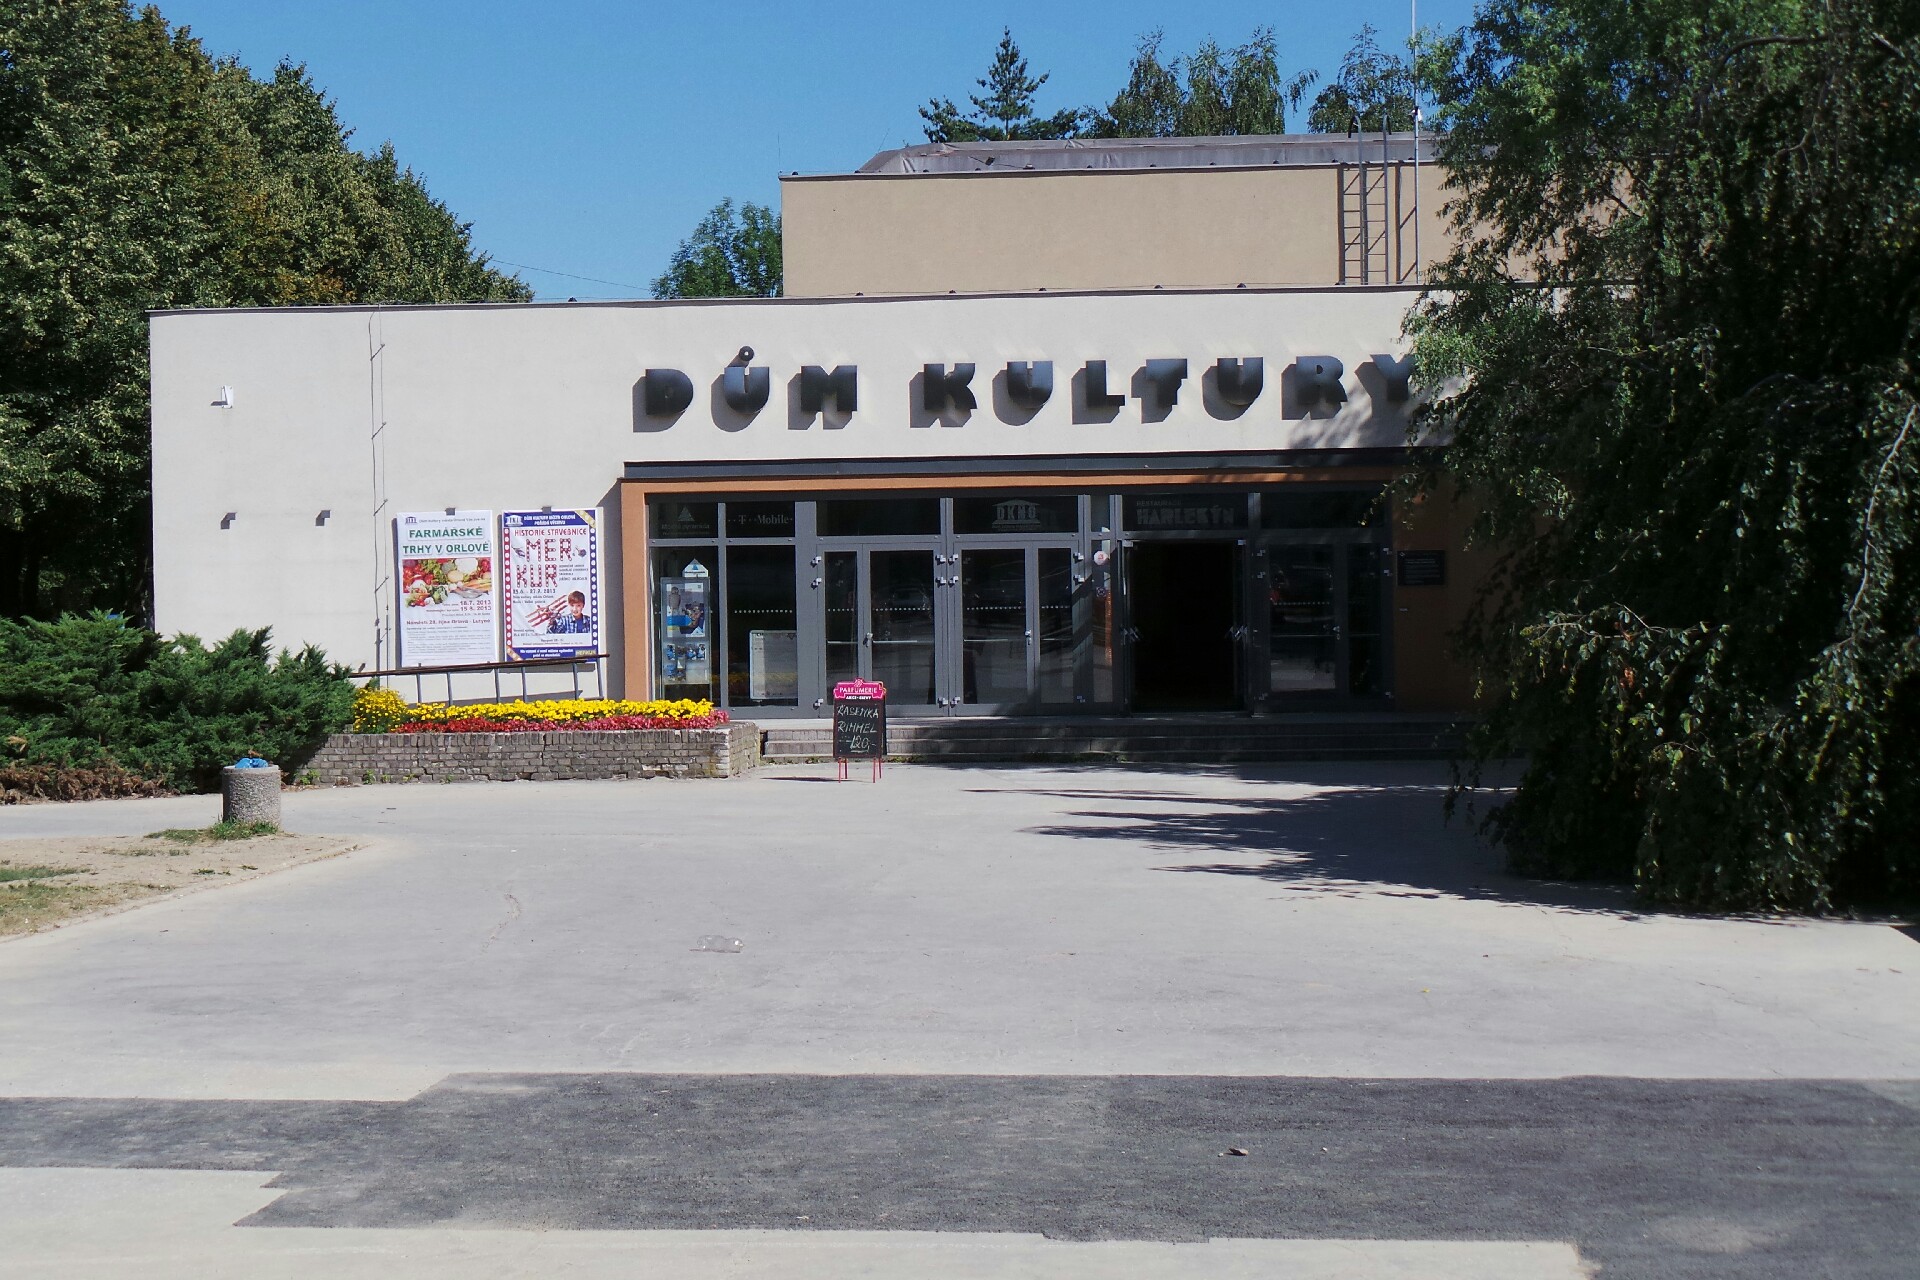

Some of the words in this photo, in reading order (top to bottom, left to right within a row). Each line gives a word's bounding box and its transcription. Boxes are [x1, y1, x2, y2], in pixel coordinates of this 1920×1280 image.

[643, 346, 857, 416] DŮM
[920, 355, 1414, 412] KULTURY
[1136, 505, 1234, 525] HARLEKÝN
[409, 526, 483, 538] FARMÁŘSKÉ
[547, 528, 587, 536] STAVEBNICE
[403, 544, 432, 554] TRHY
[435, 544, 443, 554] V
[446, 541, 489, 553] ORLOVÉ
[837, 720, 878, 734] RIMMEL
